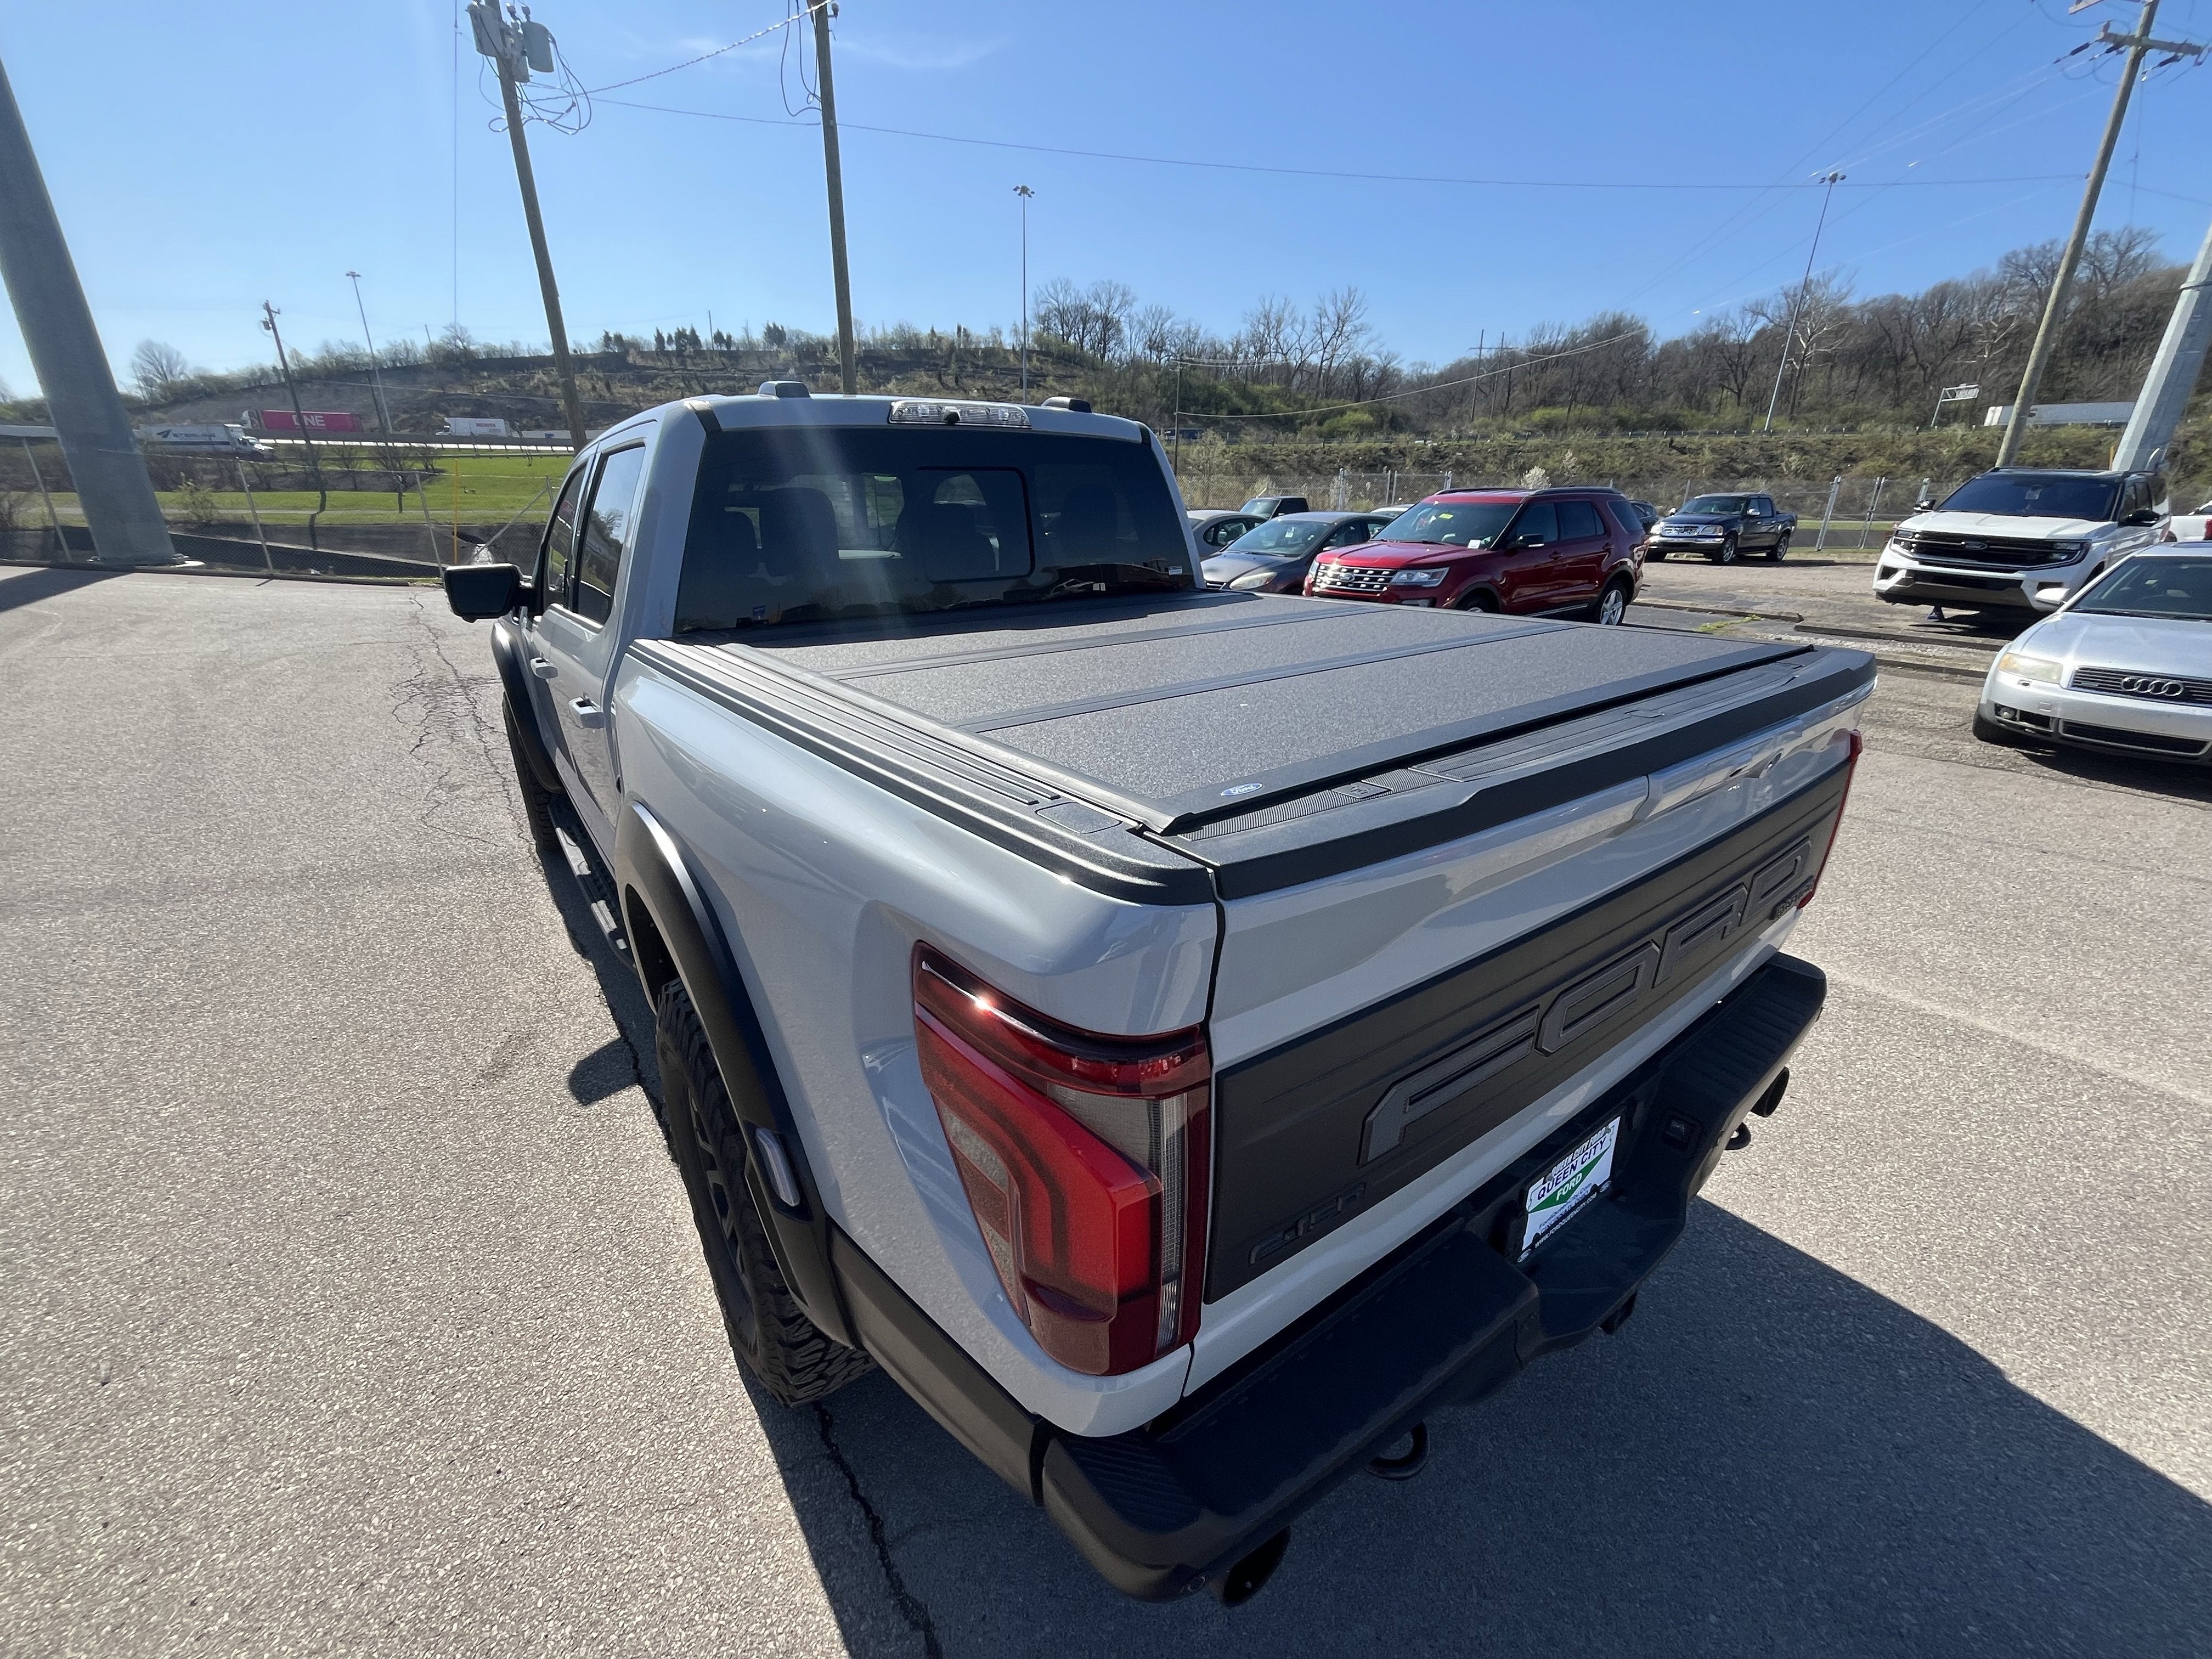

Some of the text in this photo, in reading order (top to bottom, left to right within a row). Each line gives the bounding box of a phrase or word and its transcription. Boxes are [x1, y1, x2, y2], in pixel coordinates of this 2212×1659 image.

[1358, 837, 1812, 1166] FORD
[1537, 1137, 1606, 1200] QUEEN CITY
[1556, 1173, 1583, 1201] FORD
